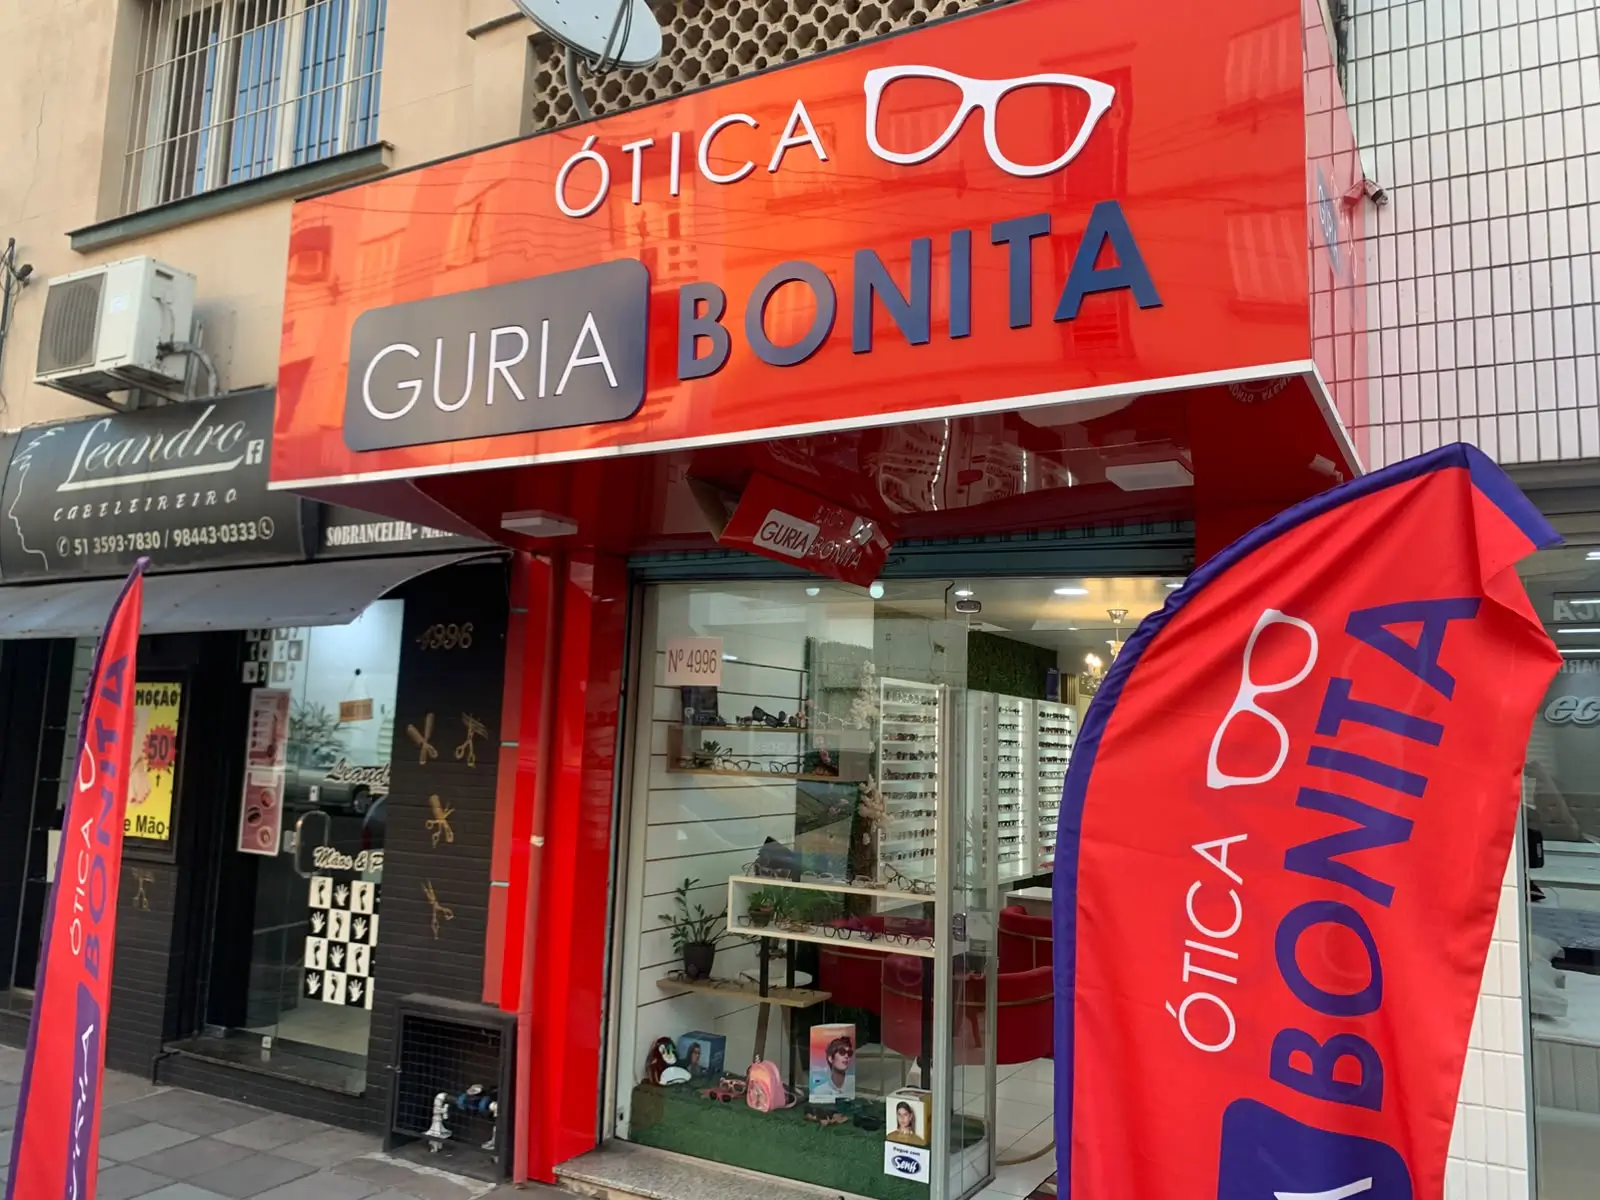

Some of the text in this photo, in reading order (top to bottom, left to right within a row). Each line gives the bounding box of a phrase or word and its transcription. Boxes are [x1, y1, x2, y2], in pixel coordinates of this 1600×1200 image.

[555, 99, 829, 218] ÓTICA
[362, 311, 620, 421] GURIA
[678, 200, 1163, 380] BONITA
[65, 404, 249, 492] Leandro
[74, 538, 89, 555] 51
[760, 520, 810, 553] GURIA
[686, 649, 717, 674] 4996
[85, 655, 127, 980] BONITA
[135, 814, 165, 835] Mão
[1268, 597, 1482, 1112] BONITA
[69, 818, 94, 956] ÓTICA
[1165, 833, 1248, 1053] ÓTICA
